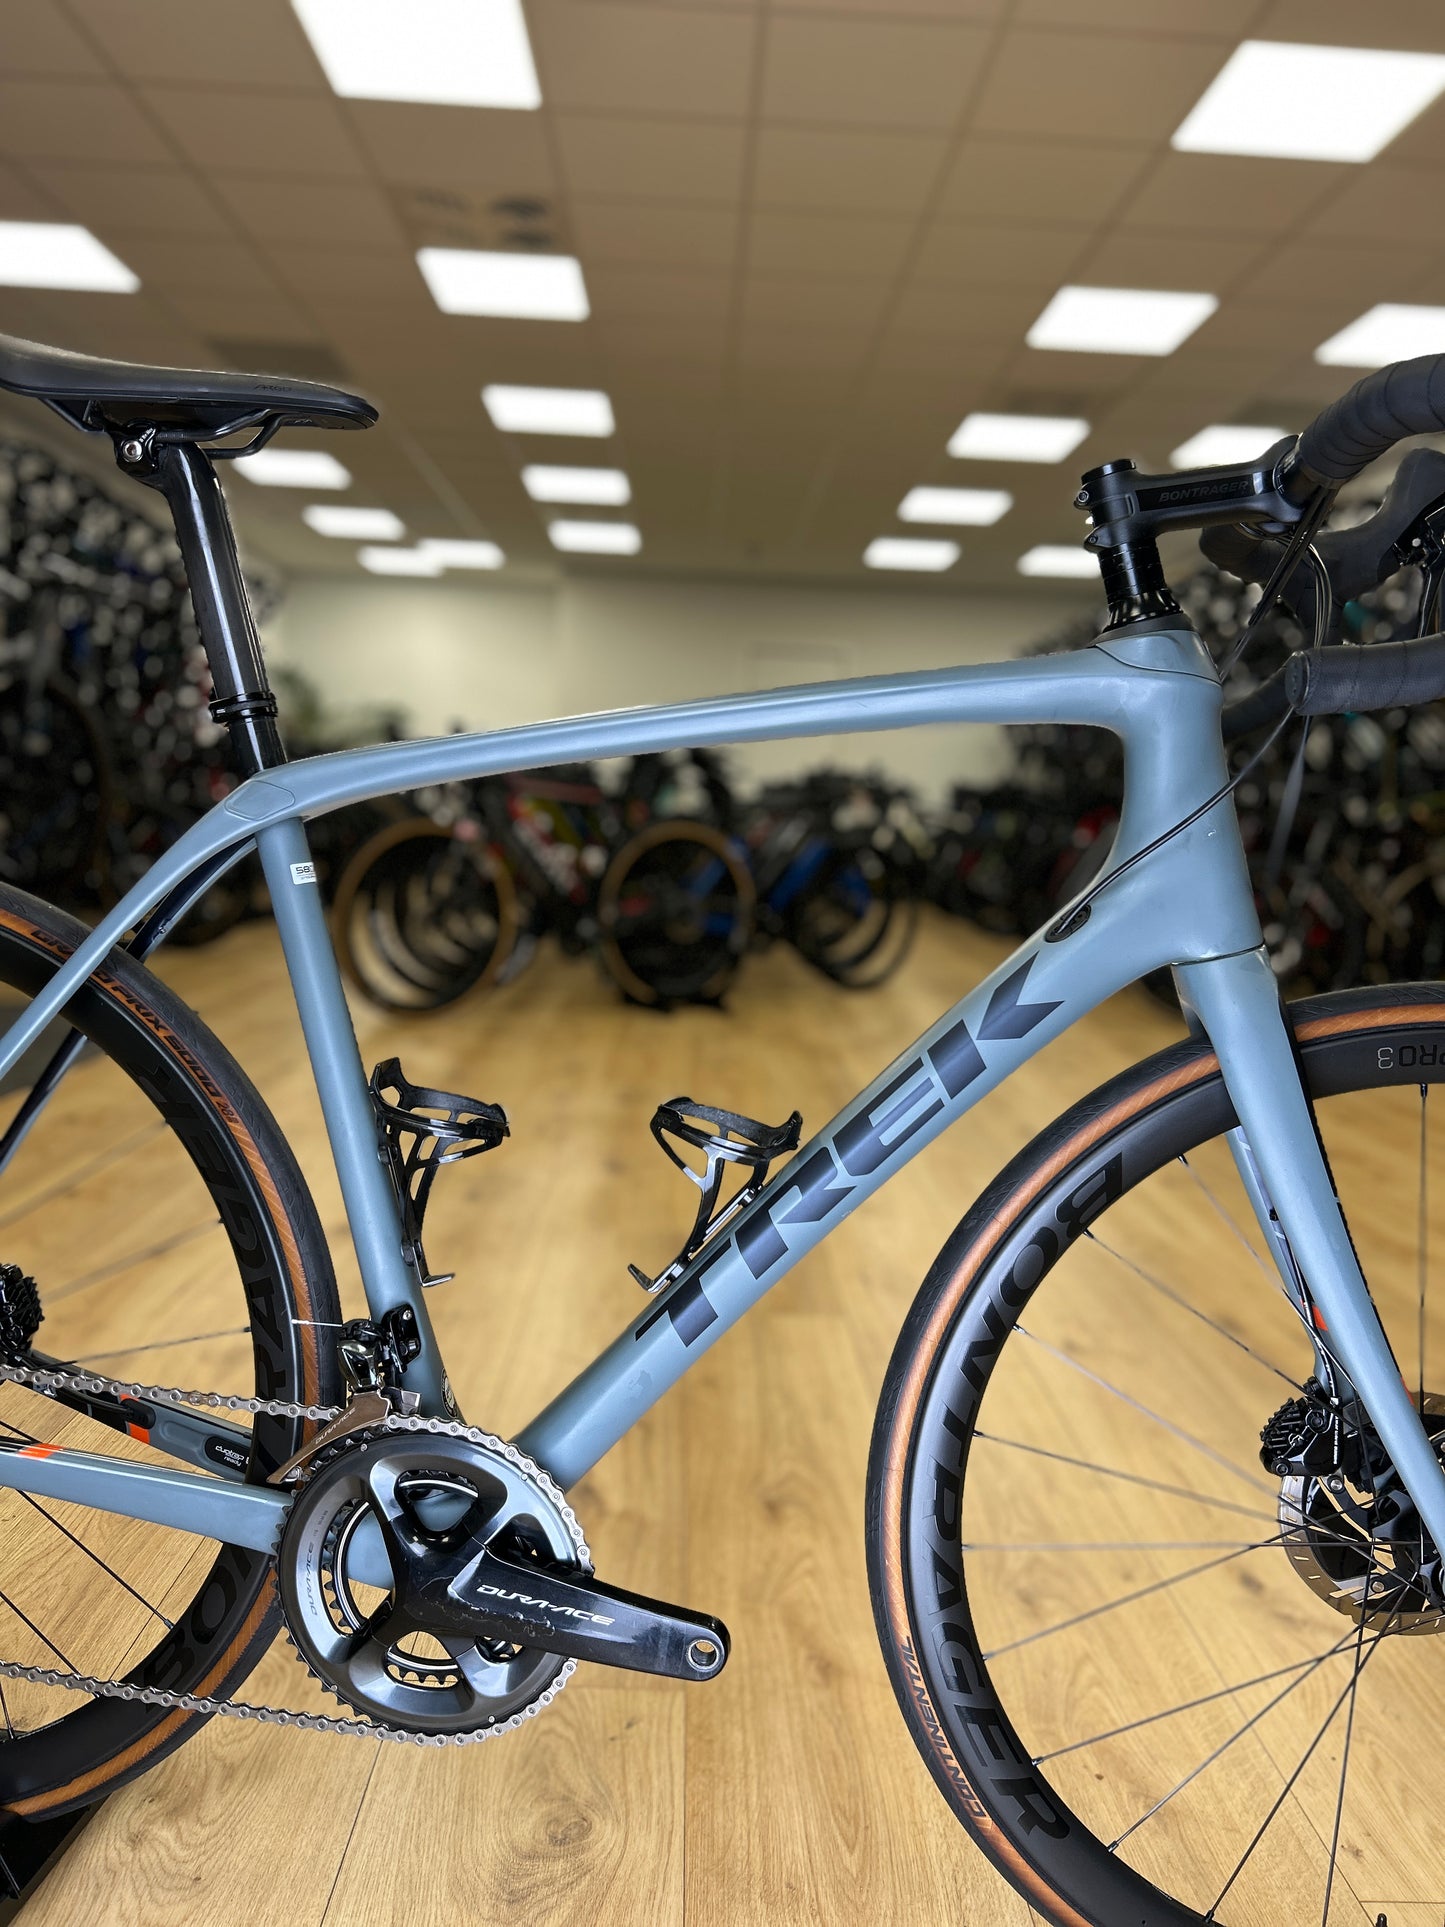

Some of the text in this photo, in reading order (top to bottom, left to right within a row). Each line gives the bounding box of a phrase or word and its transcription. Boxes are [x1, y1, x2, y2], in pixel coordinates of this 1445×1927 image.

[1159, 480, 1250, 502] BONTRAGER
[111, 983, 168, 1032] PRIX
[164, 1034, 223, 1099] 5000
[1376, 1046, 1394, 1070] 3
[635, 951, 1065, 1348] TREK
[315, 1407, 356, 1445] DURA-ACE
[921, 1151, 1123, 1841] BONTRAGER
[305, 1542, 319, 1616] DURA-ACE
[476, 1583, 616, 1626] DURA-ACE
[901, 1634, 988, 1820] CONTINENTAL
